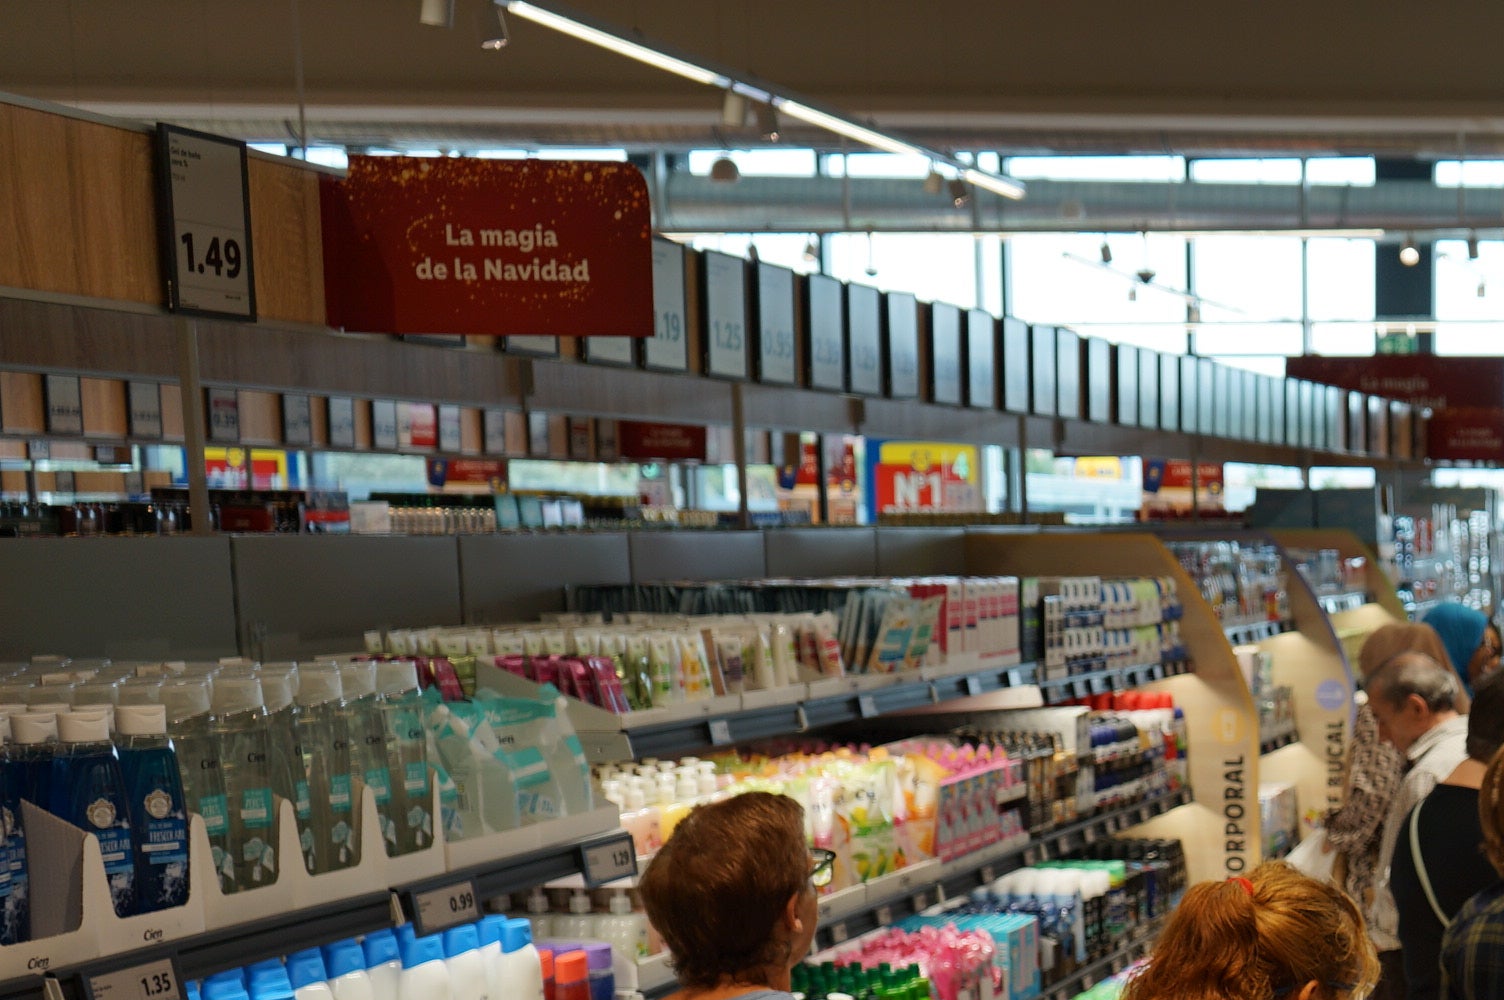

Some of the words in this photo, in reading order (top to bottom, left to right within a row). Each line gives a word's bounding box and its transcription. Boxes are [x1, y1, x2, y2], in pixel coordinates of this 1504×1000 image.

[446, 223, 474, 247] La
[479, 224, 558, 253] magia
[181, 231, 241, 279] 1.49
[416, 258, 448, 281] de
[454, 258, 477, 281] la
[483, 258, 591, 283] Navidad
[1327, 720, 1345, 787] BUCAL
[1224, 754, 1245, 879] ORPORAL
[613, 851, 629, 868] 1.29
[450, 893, 473, 912] 0.99
[144, 928, 163, 941] Cien
[27, 957, 50, 970] Cien
[141, 973, 171, 996] 1.35
